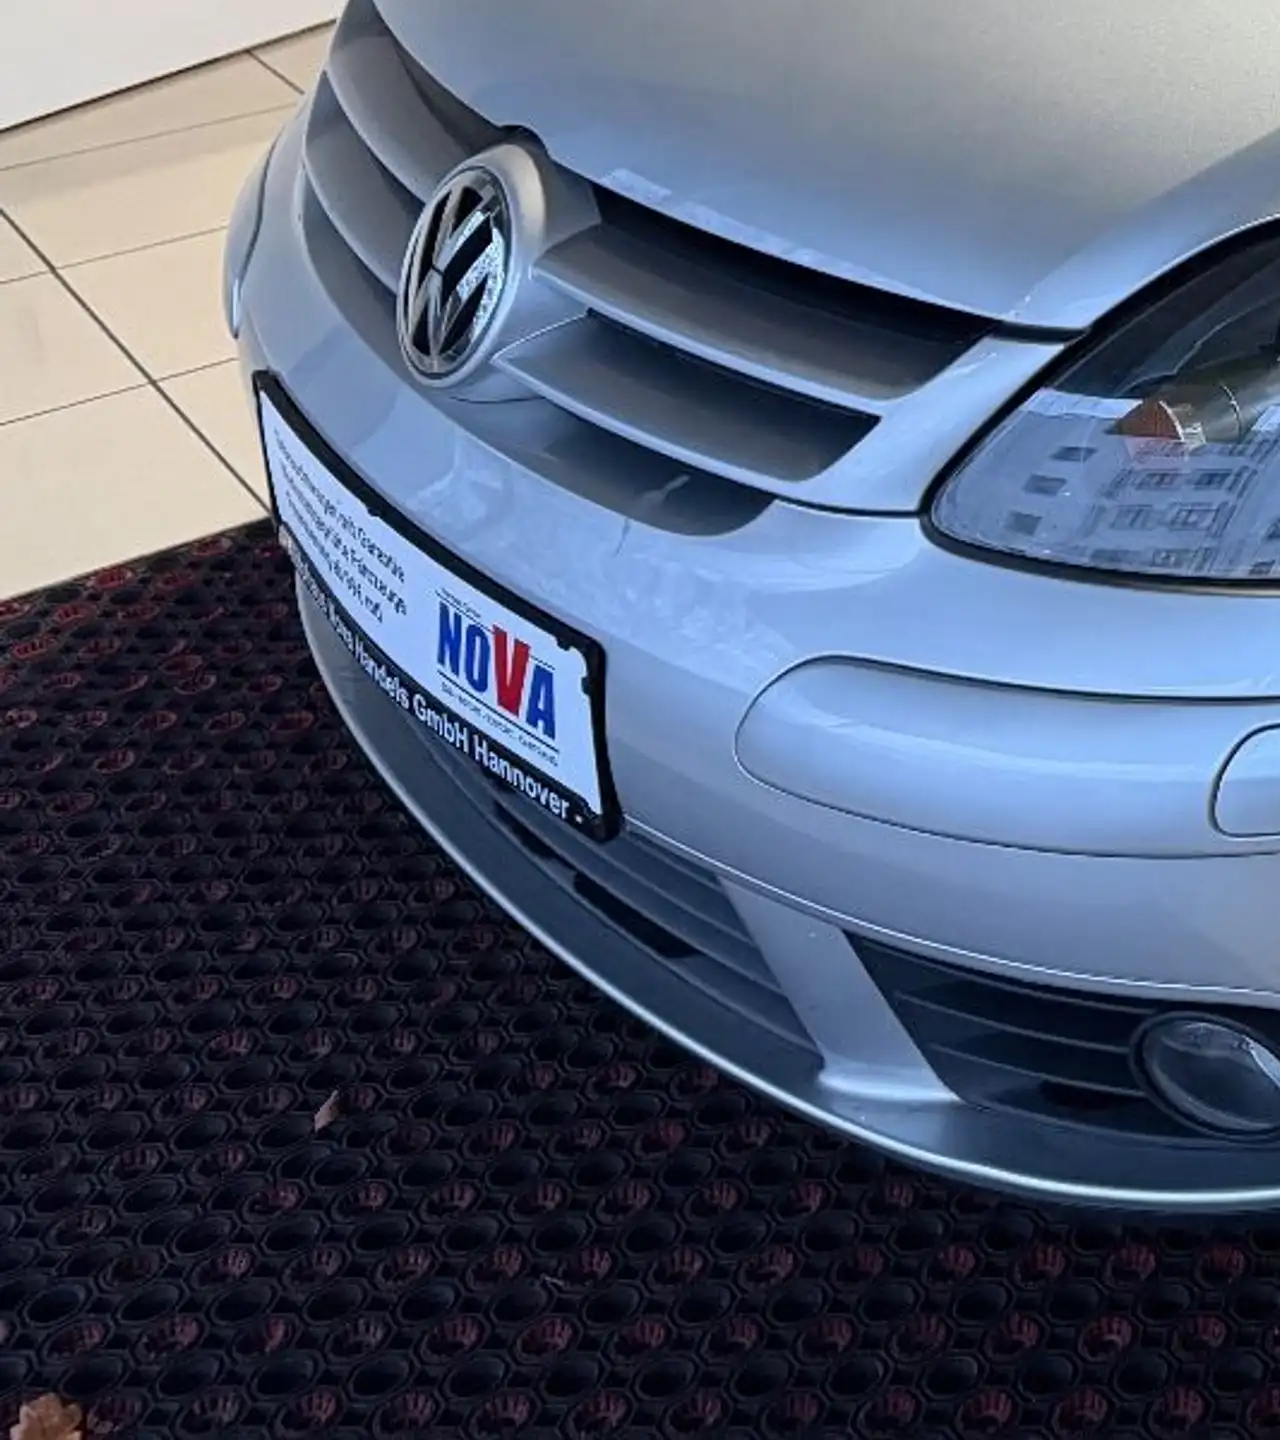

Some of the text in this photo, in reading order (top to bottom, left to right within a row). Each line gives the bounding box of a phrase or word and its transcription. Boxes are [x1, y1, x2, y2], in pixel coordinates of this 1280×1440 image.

[354, 632, 410, 711] Handels
[412, 693, 470, 754] GmbH
[473, 733, 570, 820] Hannover
[436, 599, 557, 741] NOVA
